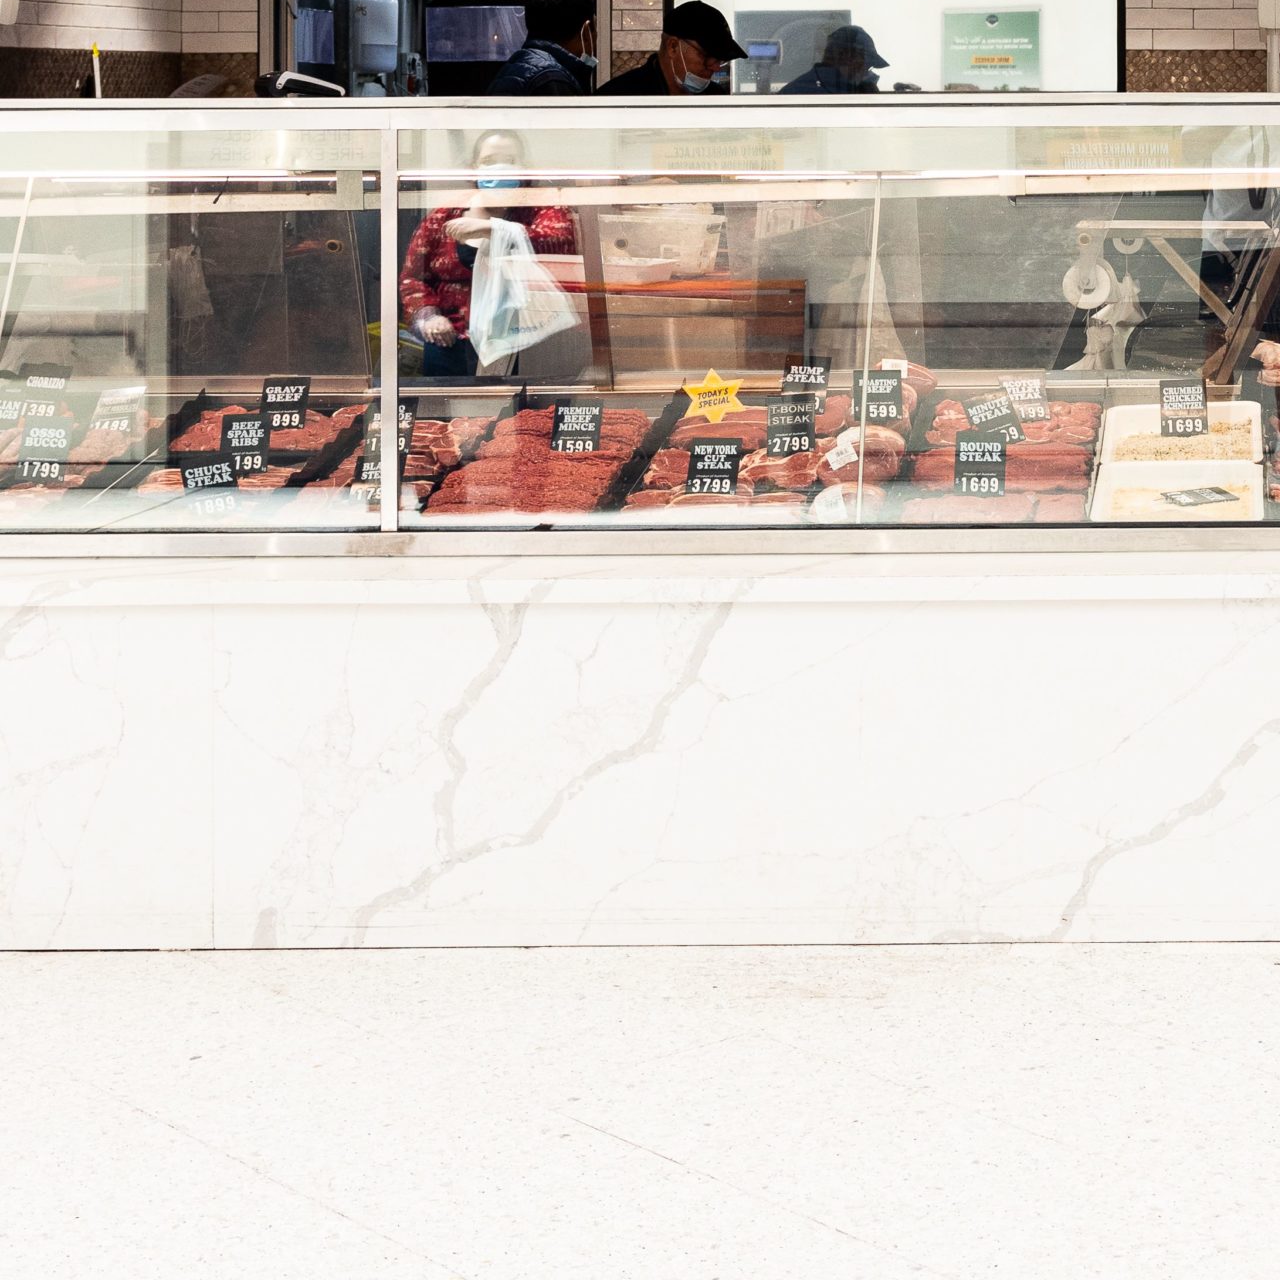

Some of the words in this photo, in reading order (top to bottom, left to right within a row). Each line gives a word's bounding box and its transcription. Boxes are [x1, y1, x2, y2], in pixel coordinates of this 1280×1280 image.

[790, 365, 824, 375] RUMP
[785, 374, 825, 384] STEAK
[265, 386, 305, 394] GRAVY
[697, 388, 729, 400] TODAY'S
[1163, 387, 1203, 395] CRUMBED
[266, 393, 302, 402] BEEF
[698, 396, 731, 409] SPECIAL
[1163, 394, 1203, 402] CHICKEN
[558, 407, 600, 415] PREMIUM
[771, 405, 813, 414] T-BONE
[967, 396, 1009, 417] MINUTE
[564, 414, 592, 423] BEEF
[772, 415, 811, 425] STEAK
[972, 405, 1011, 425] STEAK
[232, 421, 262, 430] BEEF
[559, 423, 596, 431] MINCE
[30, 428, 66, 438] OSSO
[227, 429, 264, 439] SPARE
[24, 437, 67, 448] BUCCO
[231, 438, 259, 447] RIBS
[959, 442, 1002, 452] ROUND
[694, 445, 713, 455] NEW
[714, 445, 737, 455] YORK
[959, 452, 1002, 462] STEAK
[696, 461, 732, 469] STEAK
[184, 463, 232, 479] CHUCK
[187, 472, 234, 489] STEAK
